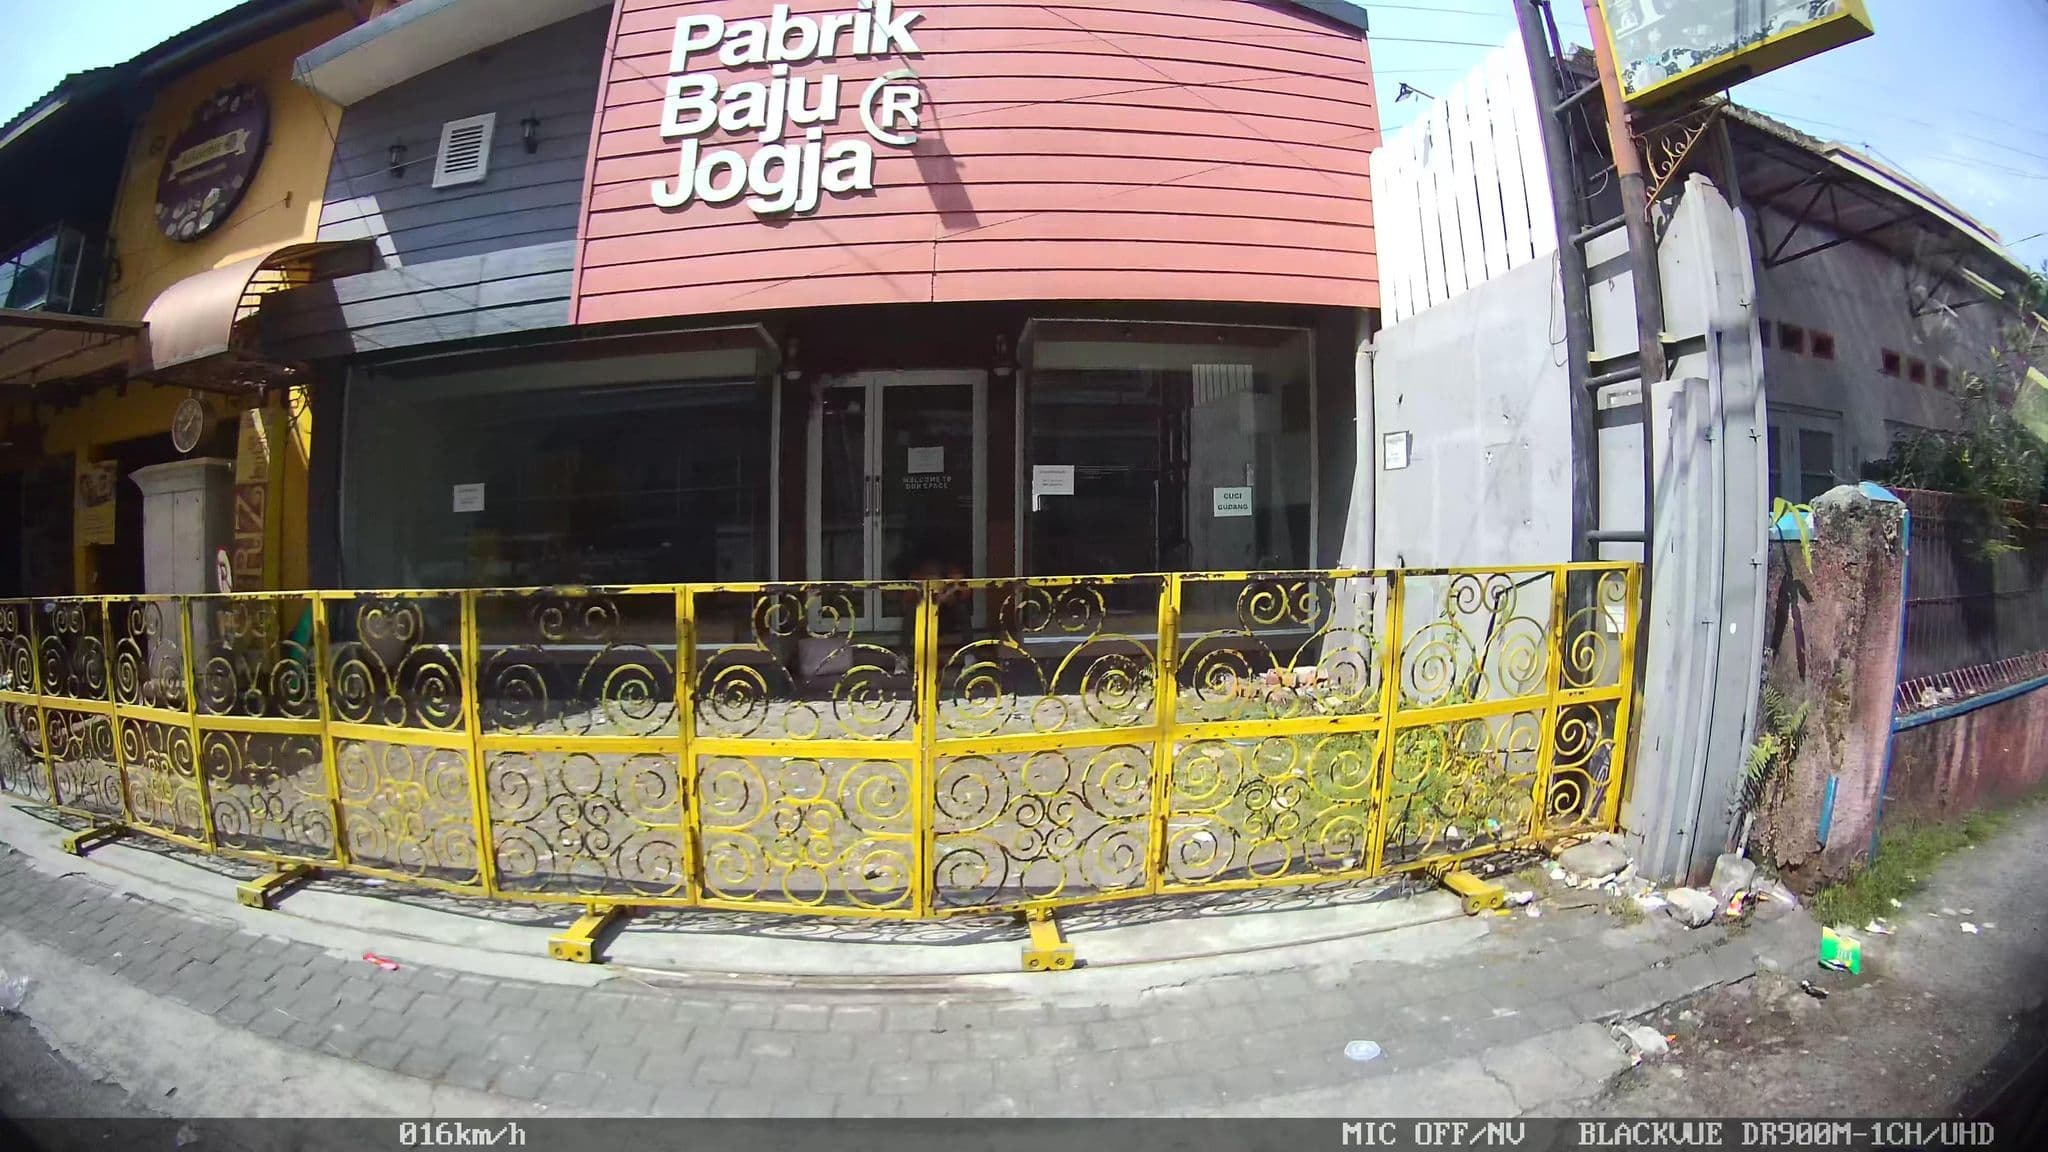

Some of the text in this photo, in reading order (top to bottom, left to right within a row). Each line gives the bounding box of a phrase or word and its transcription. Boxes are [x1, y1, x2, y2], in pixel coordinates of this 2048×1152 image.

[668, 0, 921, 72] Pabrik
[660, 64, 839, 143] Baju
[651, 127, 874, 214] Jogja
[1223, 492, 1242, 500] CUCI
